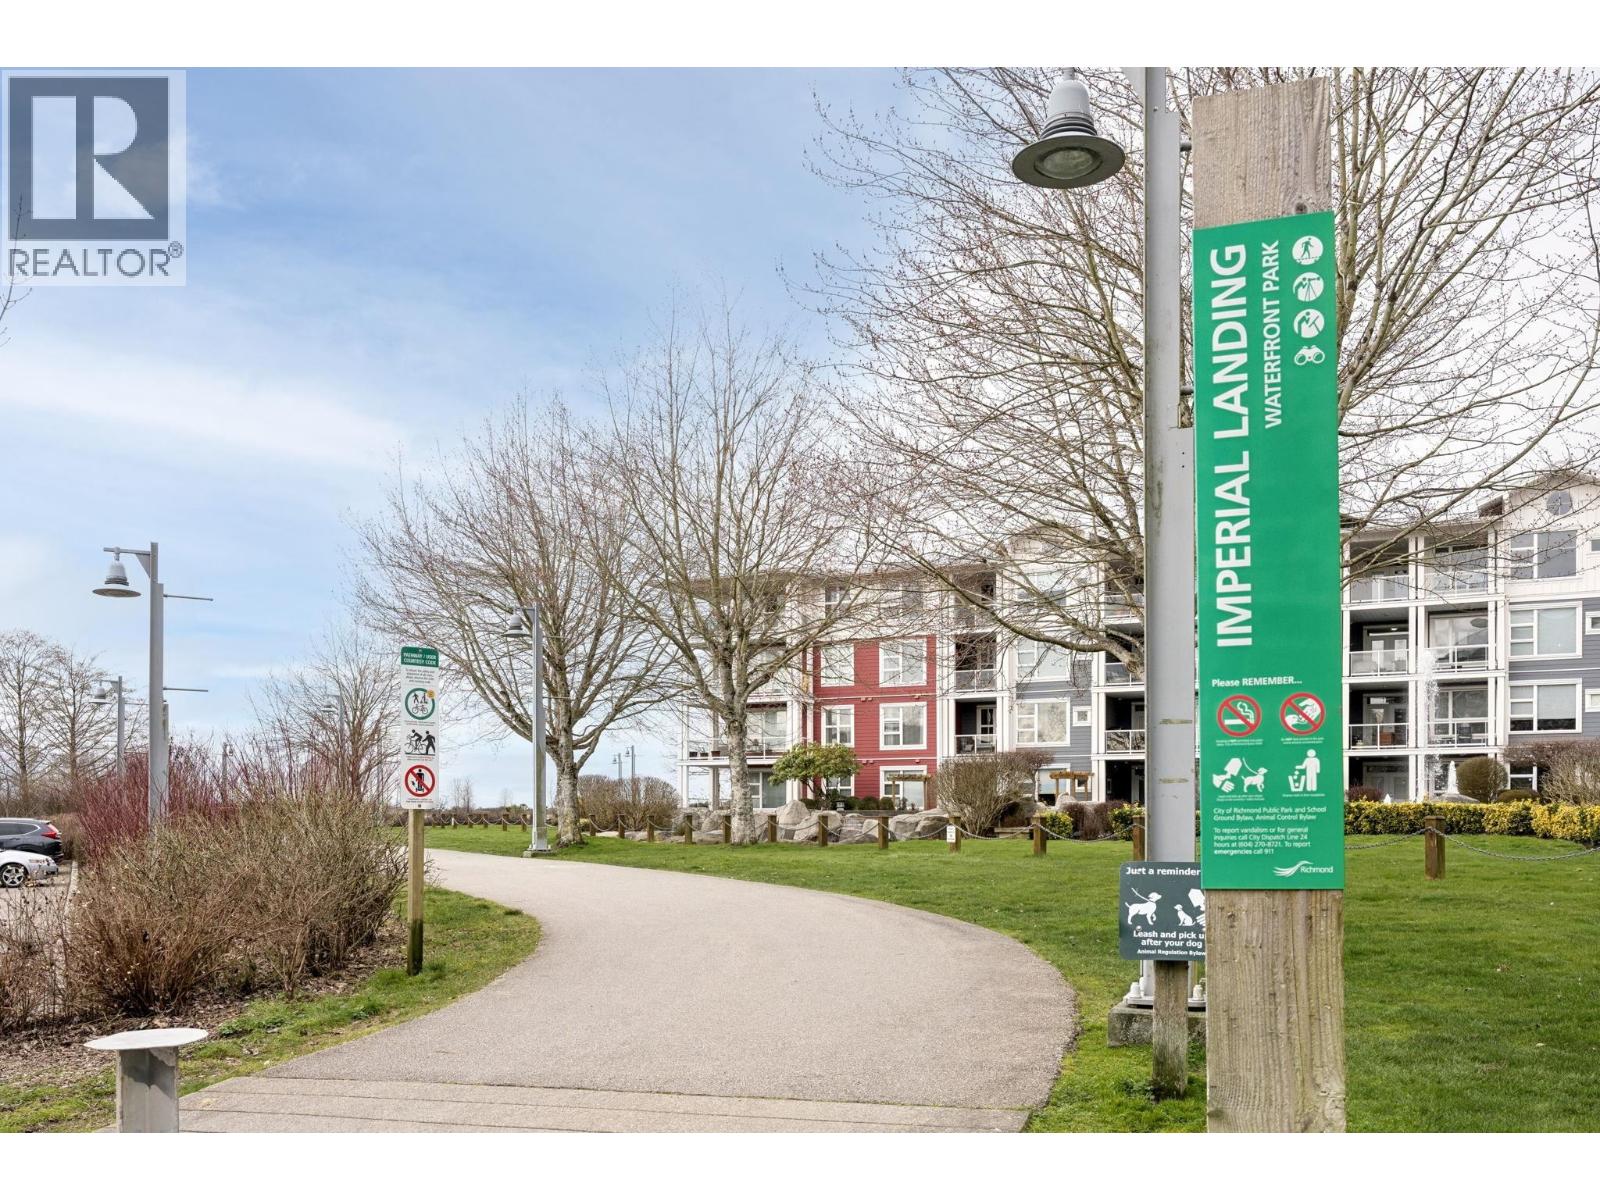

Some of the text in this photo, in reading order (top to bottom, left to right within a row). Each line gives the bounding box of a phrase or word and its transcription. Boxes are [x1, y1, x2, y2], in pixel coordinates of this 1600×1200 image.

[1261, 240, 1282, 429] WATERFRONT PARK
[1209, 243, 1253, 647] IMPERIAL LANDING
[1212, 676, 1303, 687] Please REMEMBER...
[1126, 867, 1146, 875] Just
[1133, 930, 1158, 938] Leash
[1160, 930, 1177, 938] and
[1179, 930, 1196, 940] pick
[1141, 938, 1203, 949] after your dog
